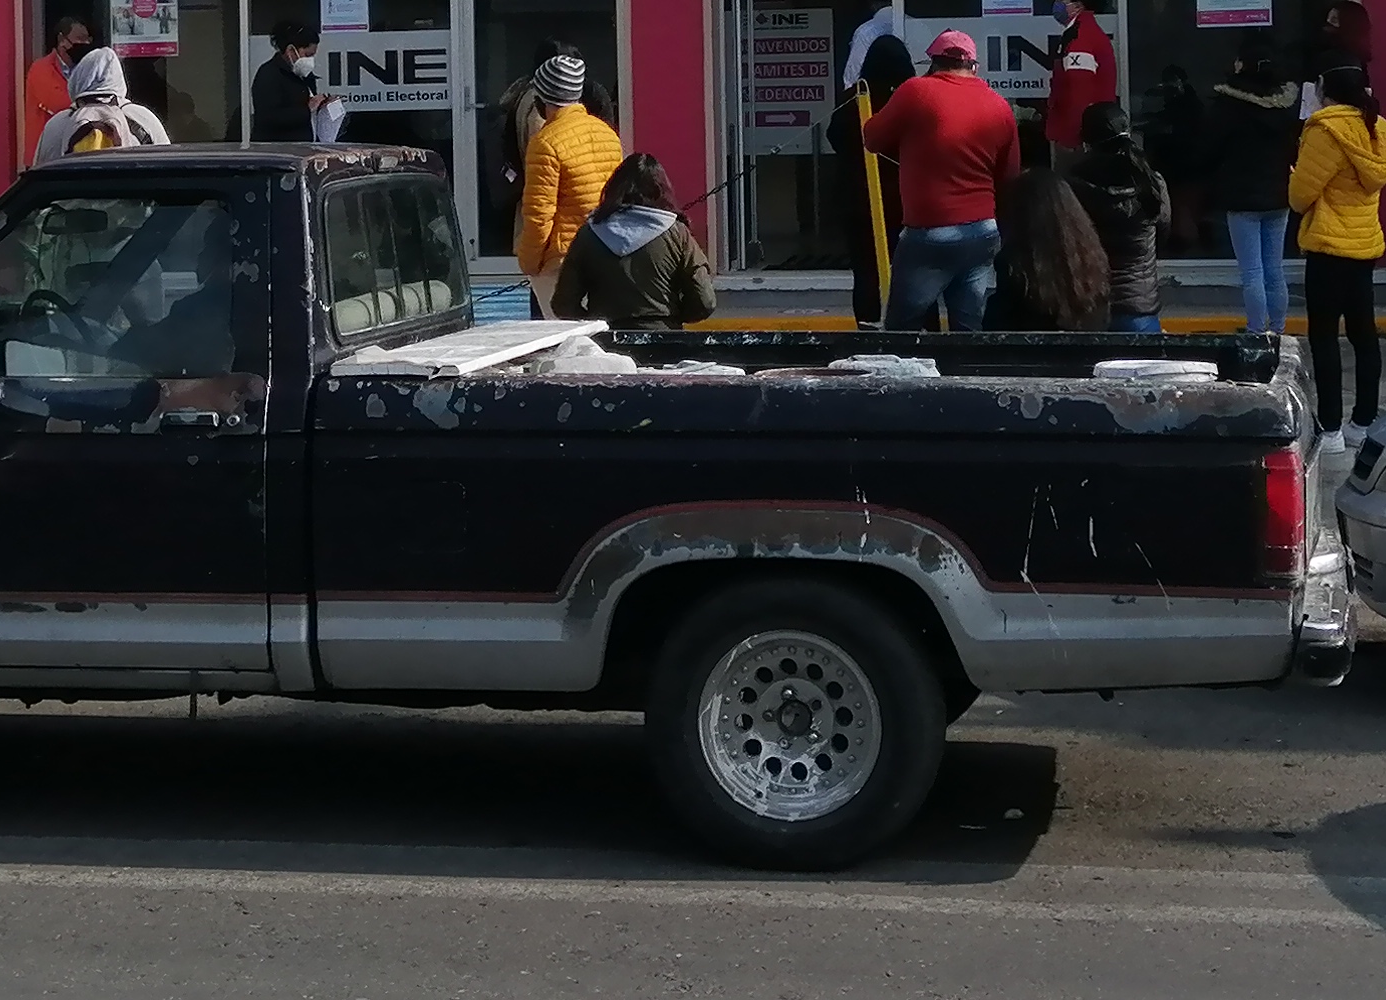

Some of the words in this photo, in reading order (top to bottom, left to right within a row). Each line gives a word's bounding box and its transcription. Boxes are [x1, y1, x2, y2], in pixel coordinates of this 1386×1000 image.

[771, 13, 809, 26] INE
[754, 39, 827, 53] NVENIDOS
[986, 33, 1113, 72] IN
[328, 48, 448, 87] INE
[754, 63, 805, 77] AMITES
[809, 63, 828, 76] DE
[386, 89, 448, 102] Electoral
